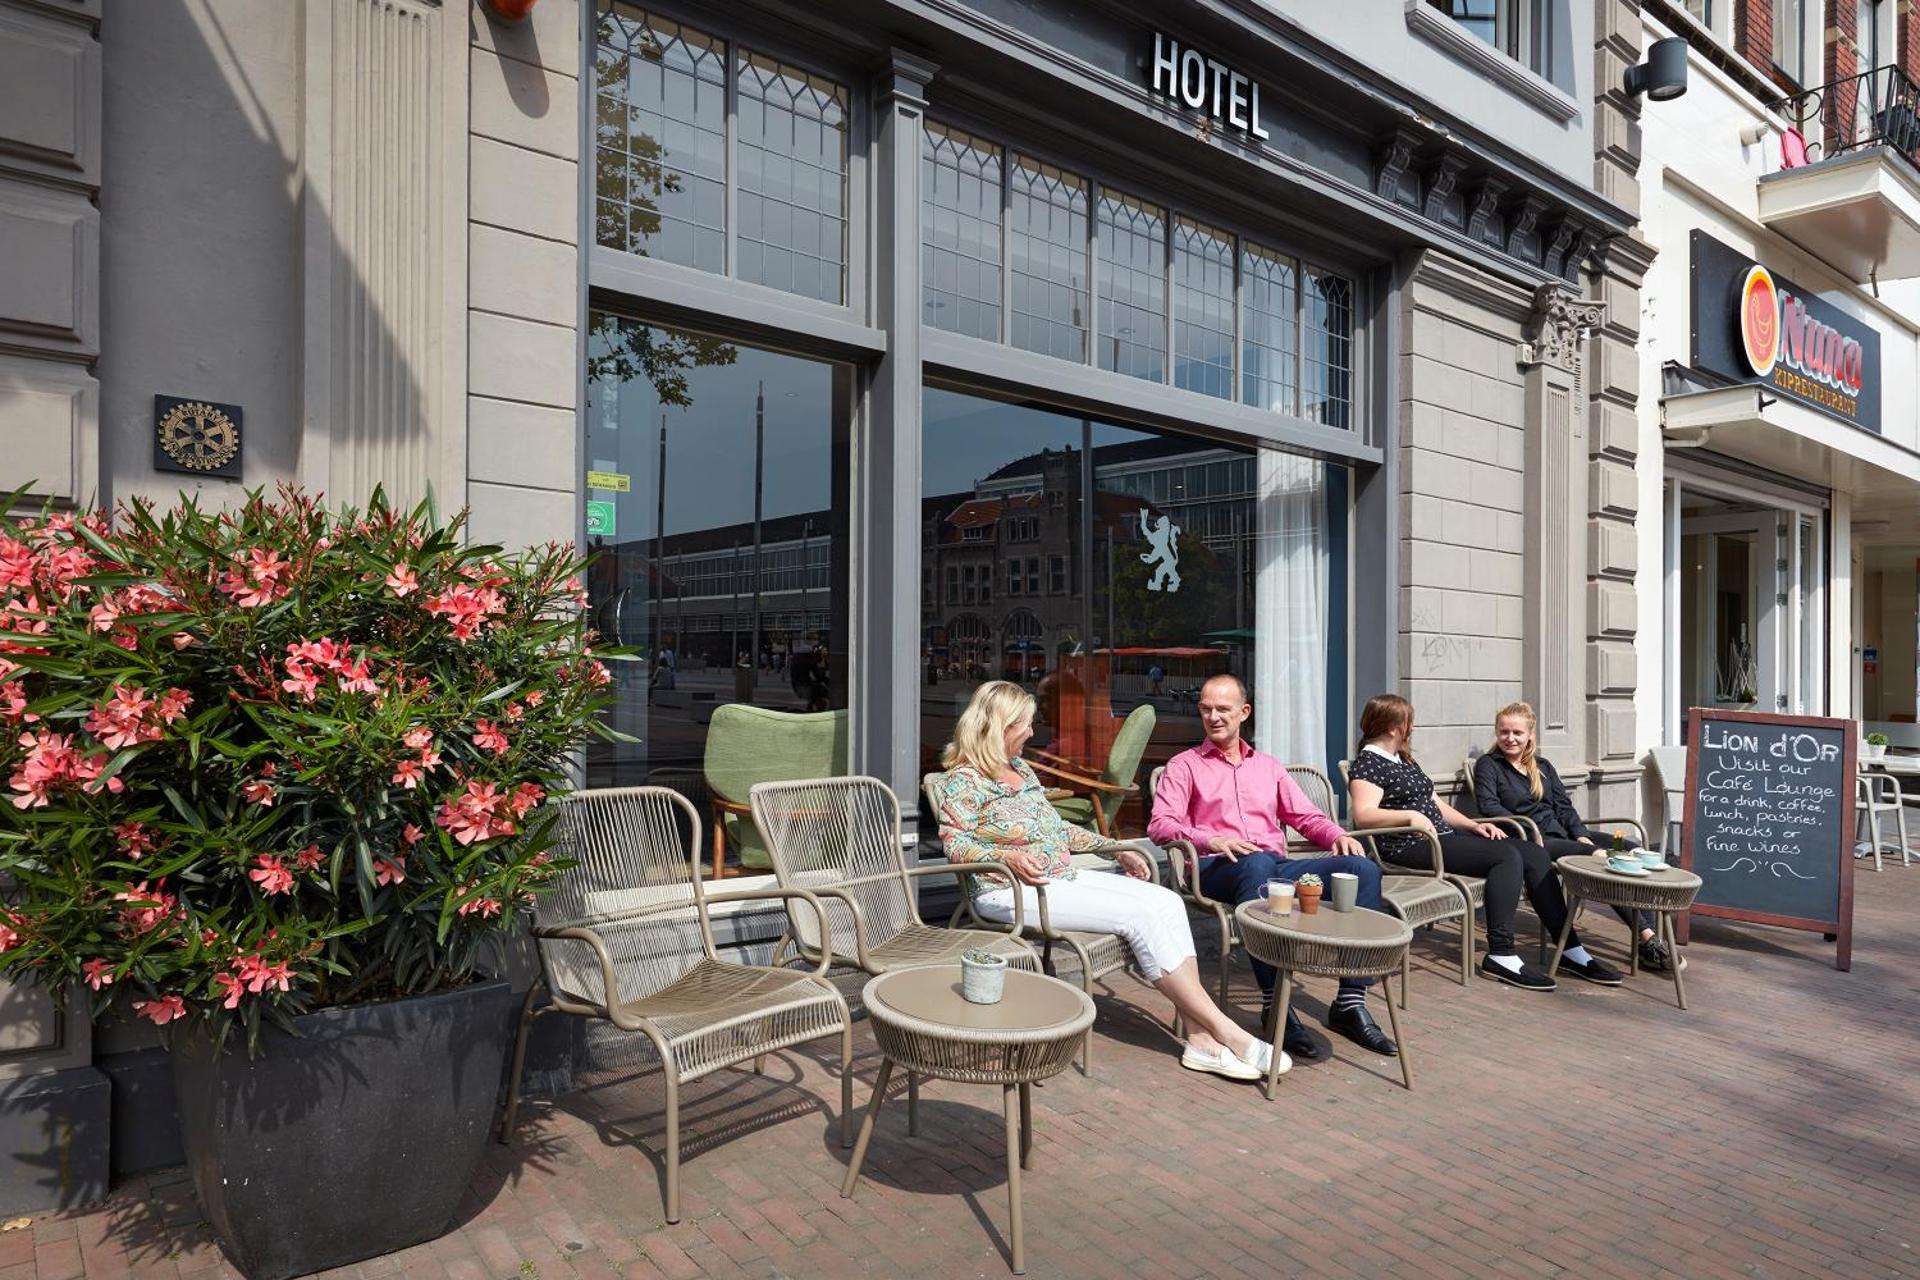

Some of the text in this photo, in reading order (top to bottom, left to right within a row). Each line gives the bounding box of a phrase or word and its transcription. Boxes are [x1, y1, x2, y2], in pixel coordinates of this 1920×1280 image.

[1153, 32, 1269, 140] HOTEL
[1774, 366, 1857, 417] KIPRESTAURANT
[1718, 755, 1812, 775] Visit our
[1707, 771, 1836, 803] Café Lounge
[1720, 796, 1729, 804] a
[1734, 795, 1772, 809] drink,
[1716, 823, 1773, 837] snacks
[1748, 840, 1801, 855] wines
